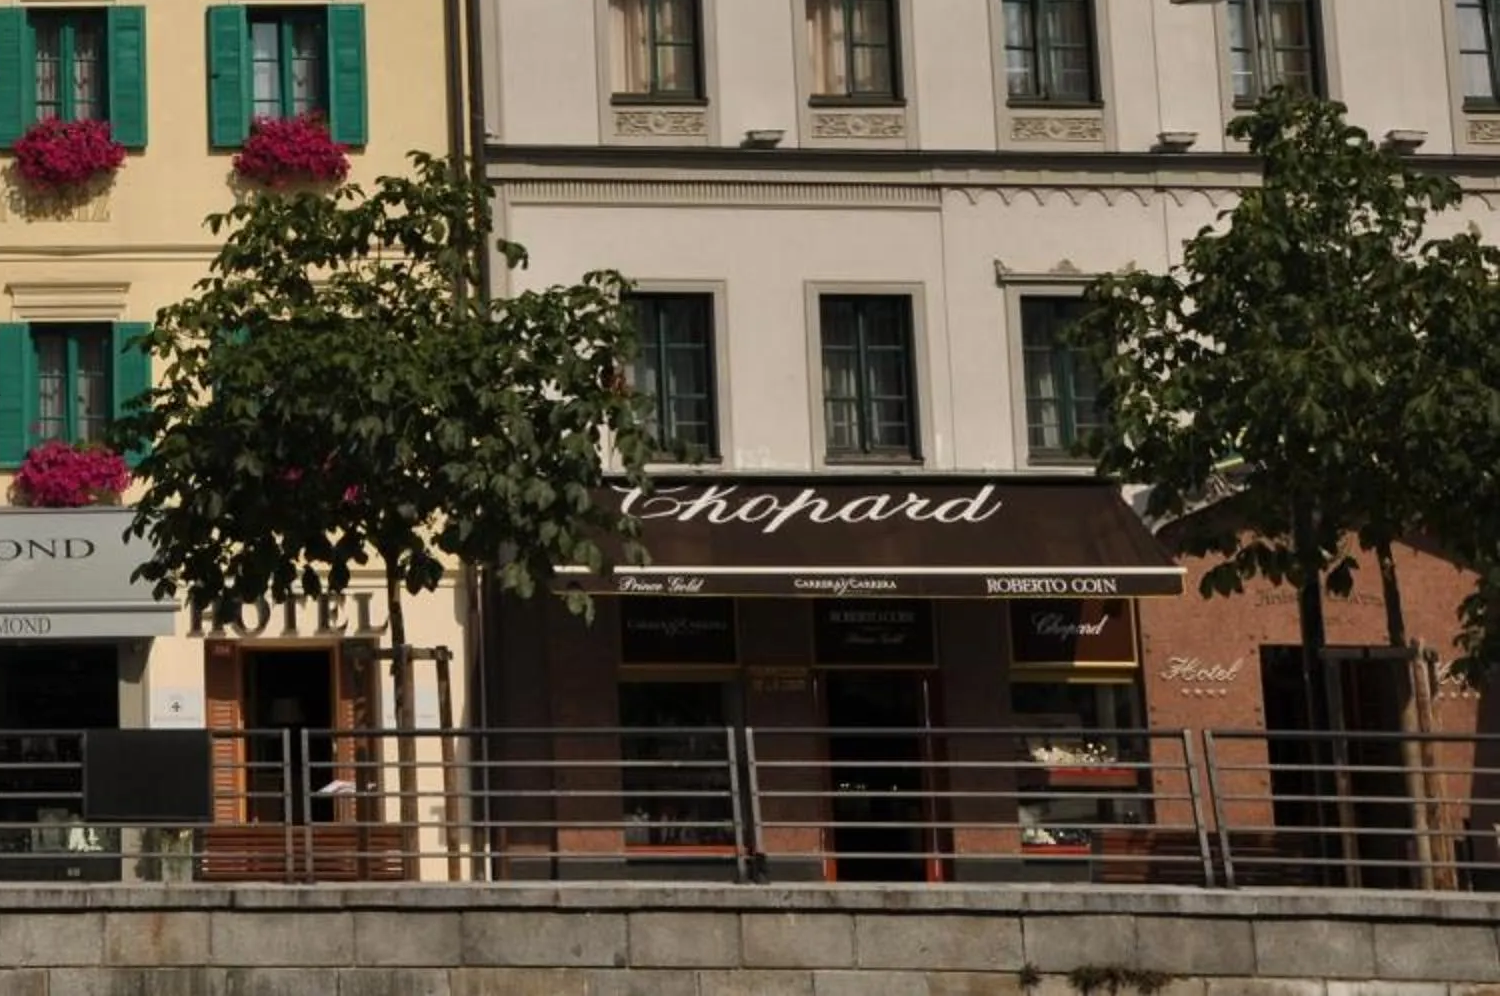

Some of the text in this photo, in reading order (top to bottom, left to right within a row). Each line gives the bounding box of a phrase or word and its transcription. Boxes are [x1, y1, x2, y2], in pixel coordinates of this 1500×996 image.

[612, 484, 1002, 534] Chopard
[986, 577, 1117, 594] ROBERTO COIN
[186, 591, 390, 638] HOTEL
[1160, 658, 1244, 683] Hotel
